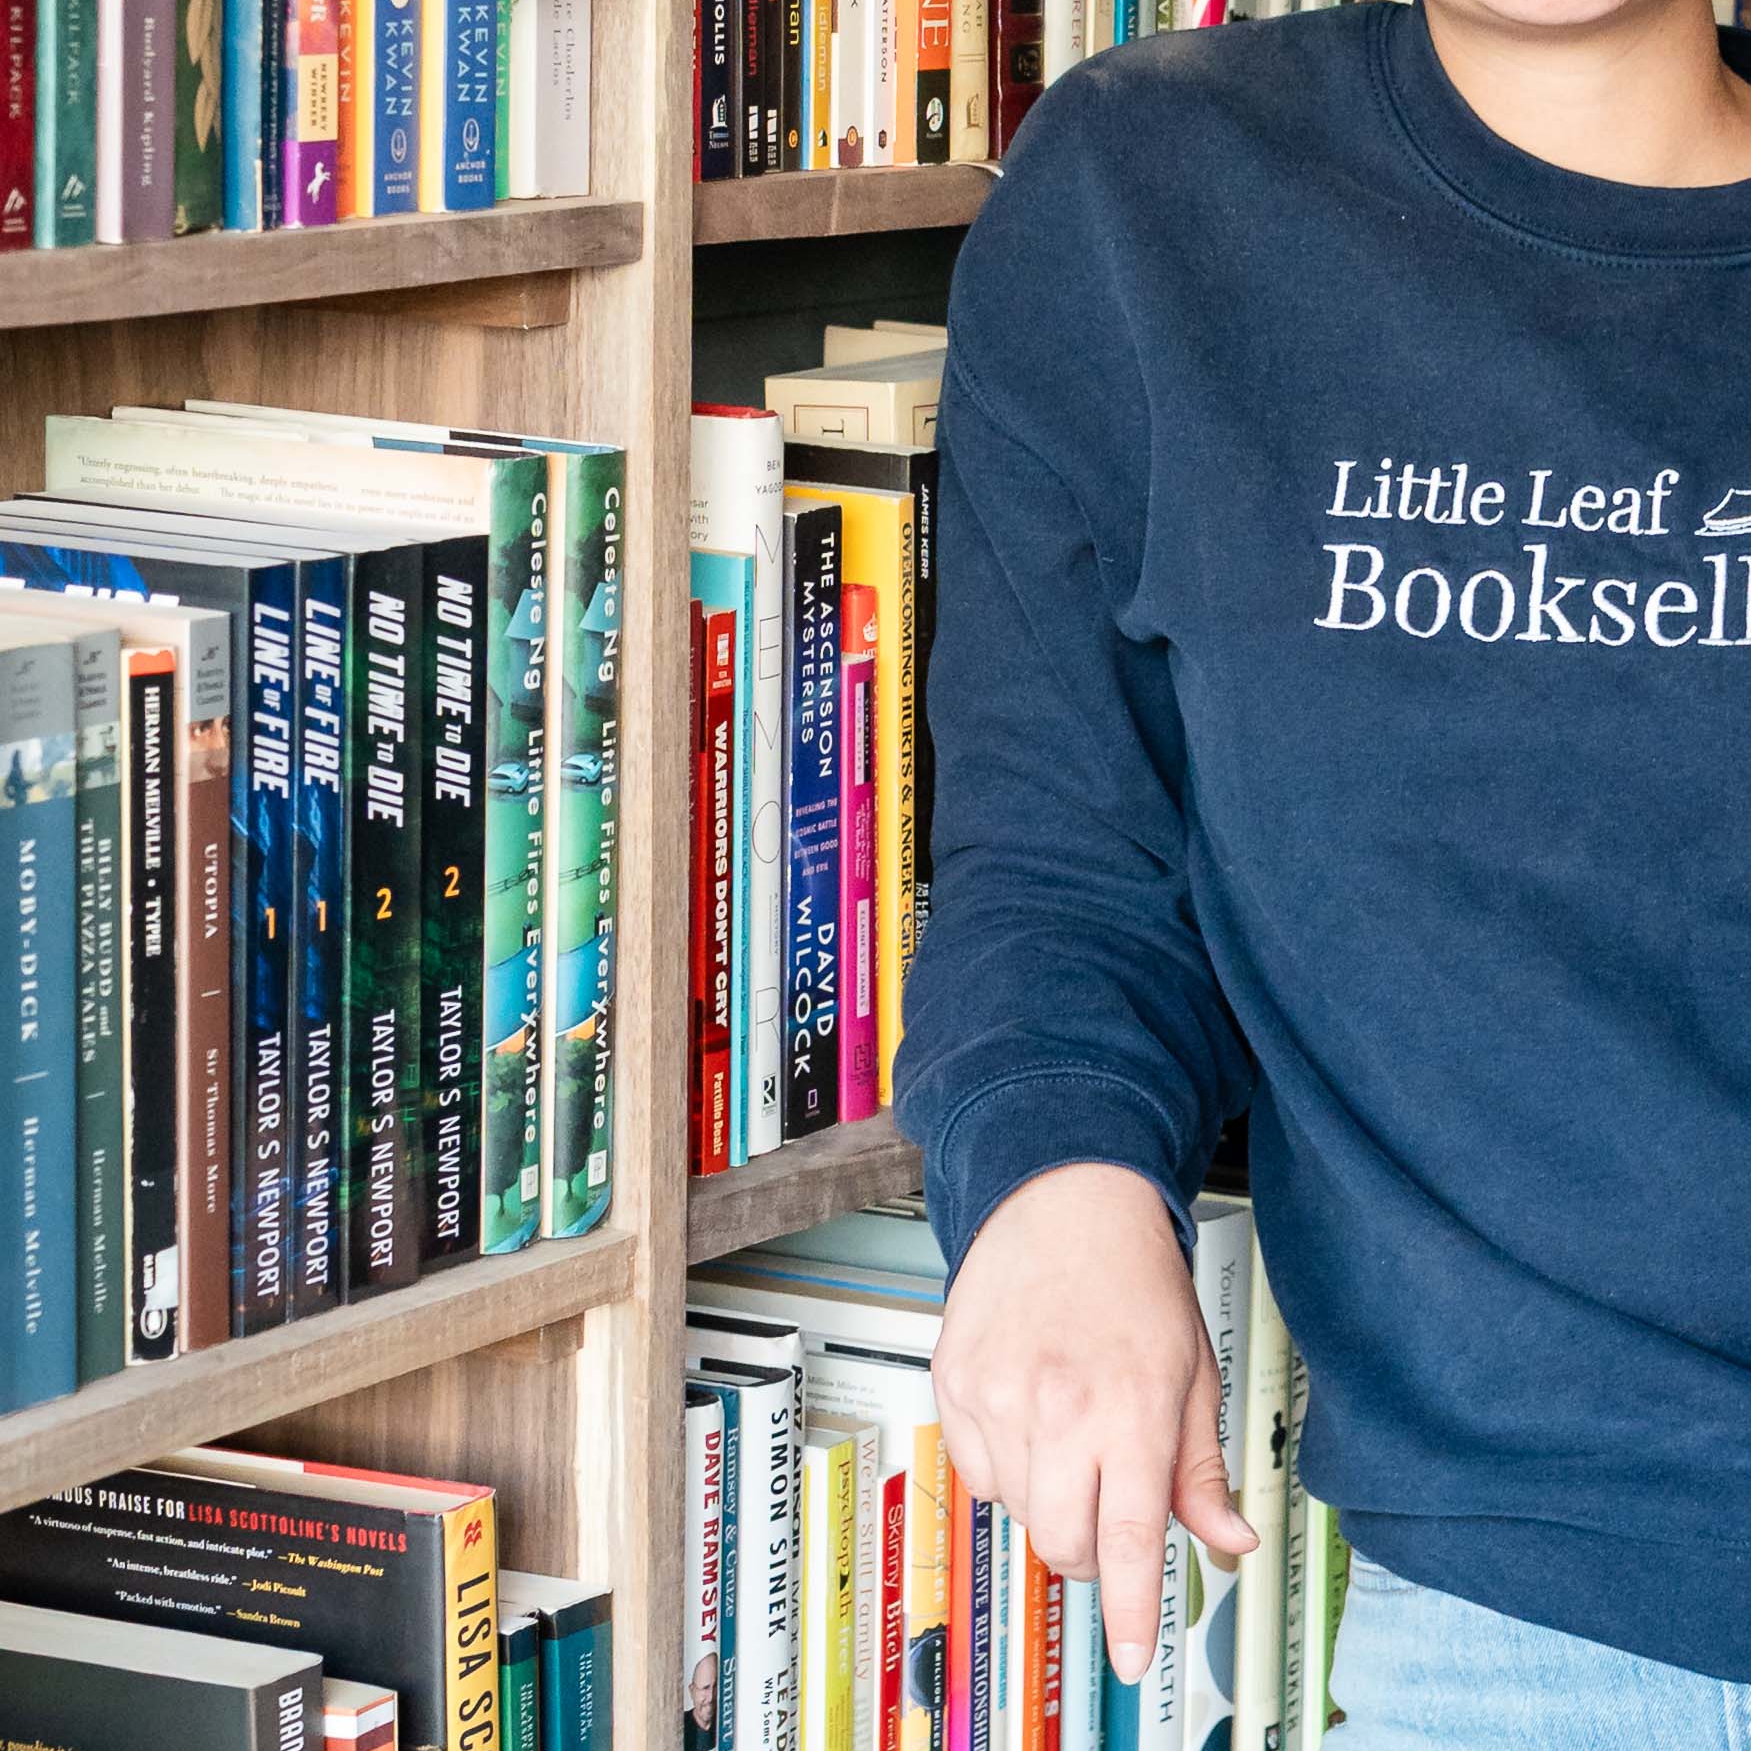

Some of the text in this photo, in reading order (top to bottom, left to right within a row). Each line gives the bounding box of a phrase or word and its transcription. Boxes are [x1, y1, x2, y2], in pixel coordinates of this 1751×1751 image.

[9, 5, 25, 120] KILPACK
[339, 0, 352, 103] KEVIN
[385, 21, 399, 116] KWAN
[401, 19, 415, 116] KEVIN
[457, 6, 472, 103] KWAN
[474, 4, 489, 103] KEVIN
[817, 6, 829, 92] idleman
[457, 172, 484, 185] BOOKS
[920, 483, 930, 580] JAMES KERR
[1325, 456, 1680, 537] Little Leaf
[523, 491, 548, 692] Celeste Ng
[597, 486, 621, 684] Celeste Ng
[253, 601, 290, 800] LINE OF FIRE
[800, 580, 816, 745] MYSTERIES
[818, 531, 835, 778] THE ASCENSION
[203, 842, 219, 940] UTOPIA
[591, 718, 617, 1130] Little Fires Everywhere
[713, 720, 729, 1030] WARRIORS DON'T CRY
[19, 838, 39, 1043] MOBY-DICK
[520, 728, 544, 1144] Little Fires Everywhere
[793, 894, 813, 1080] WILCOCK
[816, 921, 835, 1038] DAVID
[256, 1031, 281, 1299] TAYLOR S NEWPORT
[305, 1022, 331, 1287] TAYLOR S NEWPORT
[370, 1008, 395, 1270] TAYLOR S NEWPORT
[437, 984, 463, 1240] TAYLOR S NEWPORT
[100, 1489, 151, 1515] PRAISE
[157, 1497, 186, 1520] FOR
[189, 1503, 223, 1526] LISA
[229, 1509, 341, 1543] SCOTTOLINE'S
[346, 1526, 408, 1554] NOVELS
[127, 1559, 163, 1578] intense,
[163, 1564, 211, 1583] breathless
[273, 1582, 307, 1598] Picoult
[700, 1428, 722, 1644] DAVE RAMSEY
[767, 1407, 790, 1640] SIMON SINEK
[975, 1527, 990, 1610] ABUSIVE
[456, 1571, 492, 1681] LISA
[934, 1651, 942, 1705] MILLION
[933, 1708, 941, 1749] MILES
